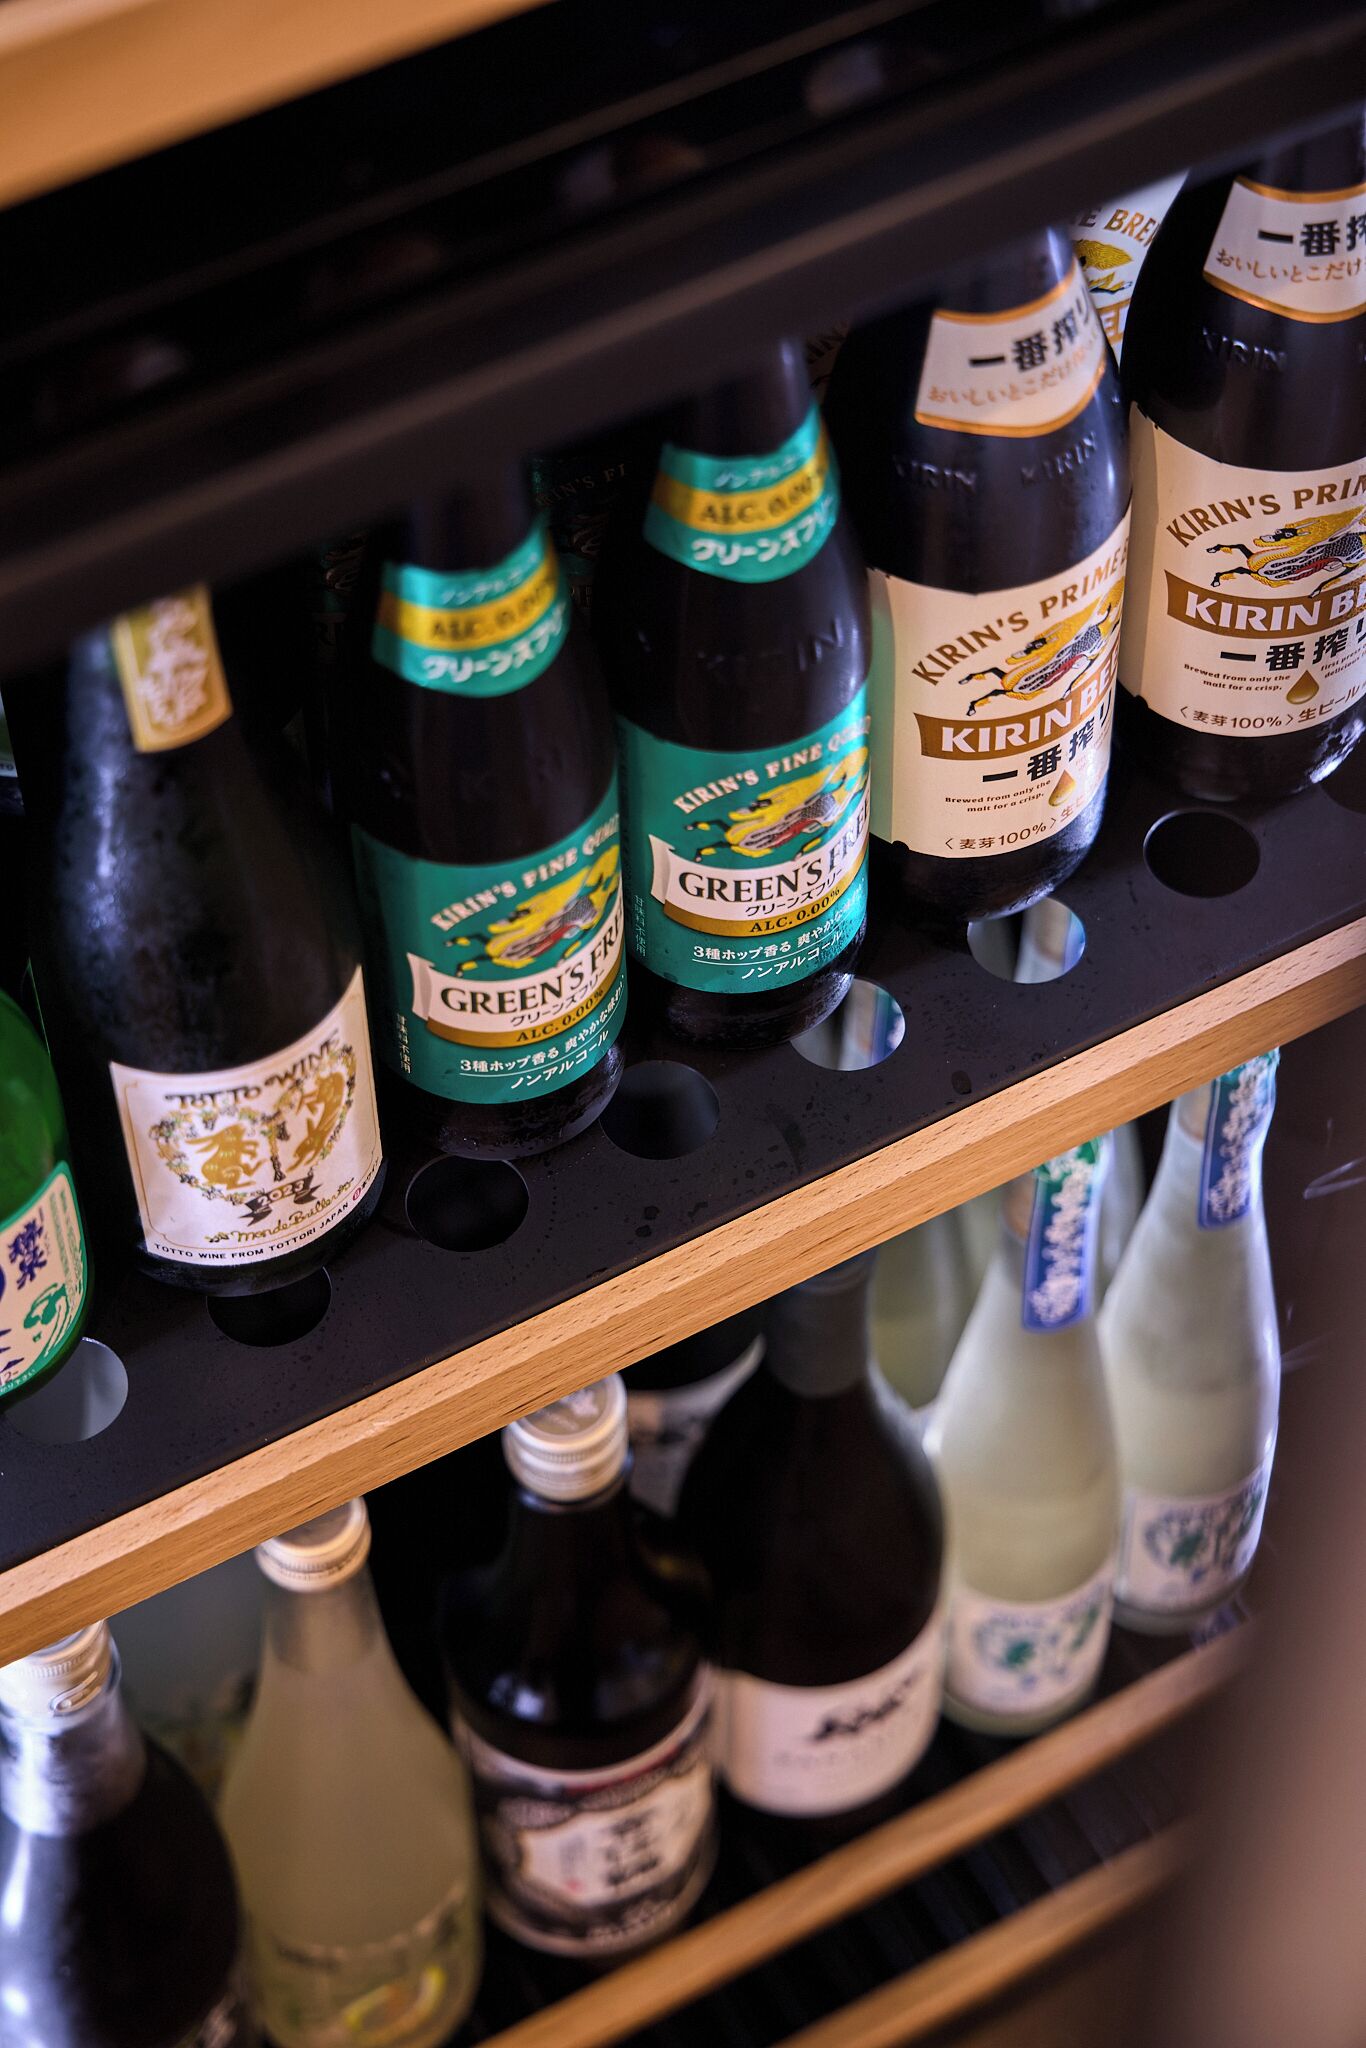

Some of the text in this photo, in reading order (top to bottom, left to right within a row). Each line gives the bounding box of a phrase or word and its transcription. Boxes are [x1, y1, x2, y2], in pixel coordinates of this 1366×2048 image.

[969, 284, 1090, 372] 一番搾り
[1166, 494, 1281, 548] KIRIN'S
[1185, 591, 1321, 632] KIRIN
[912, 611, 1029, 686] KIRIN'S
[1184, 663, 1291, 683] Brewed from only the
[1320, 660, 1339, 672] first
[1341, 647, 1361, 665] press
[1324, 656, 1360, 679] delicious
[1203, 680, 1226, 690] malt
[1254, 683, 1283, 693] crisp.
[941, 699, 1073, 754] KIRIN
[982, 689, 1112, 783] 一番搾り
[673, 742, 823, 814] KIRIN'S FINE
[966, 803, 991, 812] malt
[993, 802, 1008, 811] for
[1019, 792, 1045, 806] crisp.
[986, 794, 1011, 803] from
[1013, 786, 1034, 799] only
[1036, 779, 1051, 791] the
[430, 847, 578, 932] KIRIN'S FINE
[678, 858, 822, 904] GREEN'S
[745, 868, 842, 917] グリーンズフリー
[749, 887, 841, 933] ALC. 0.00%
[693, 941, 792, 961] 3種ホップ香る
[741, 930, 843, 980] ノンアルコール
[440, 961, 583, 1015] GREEN'S
[510, 969, 605, 1028] グリーンズフリー
[516, 989, 604, 1042] ALC. 0.00%
[460, 1050, 559, 1072] 3種ホップ香る
[510, 1030, 609, 1090] ノンアルコール
[154, 1202, 349, 1260] TOTTO WINE FROM TOTTORI JAPAN
